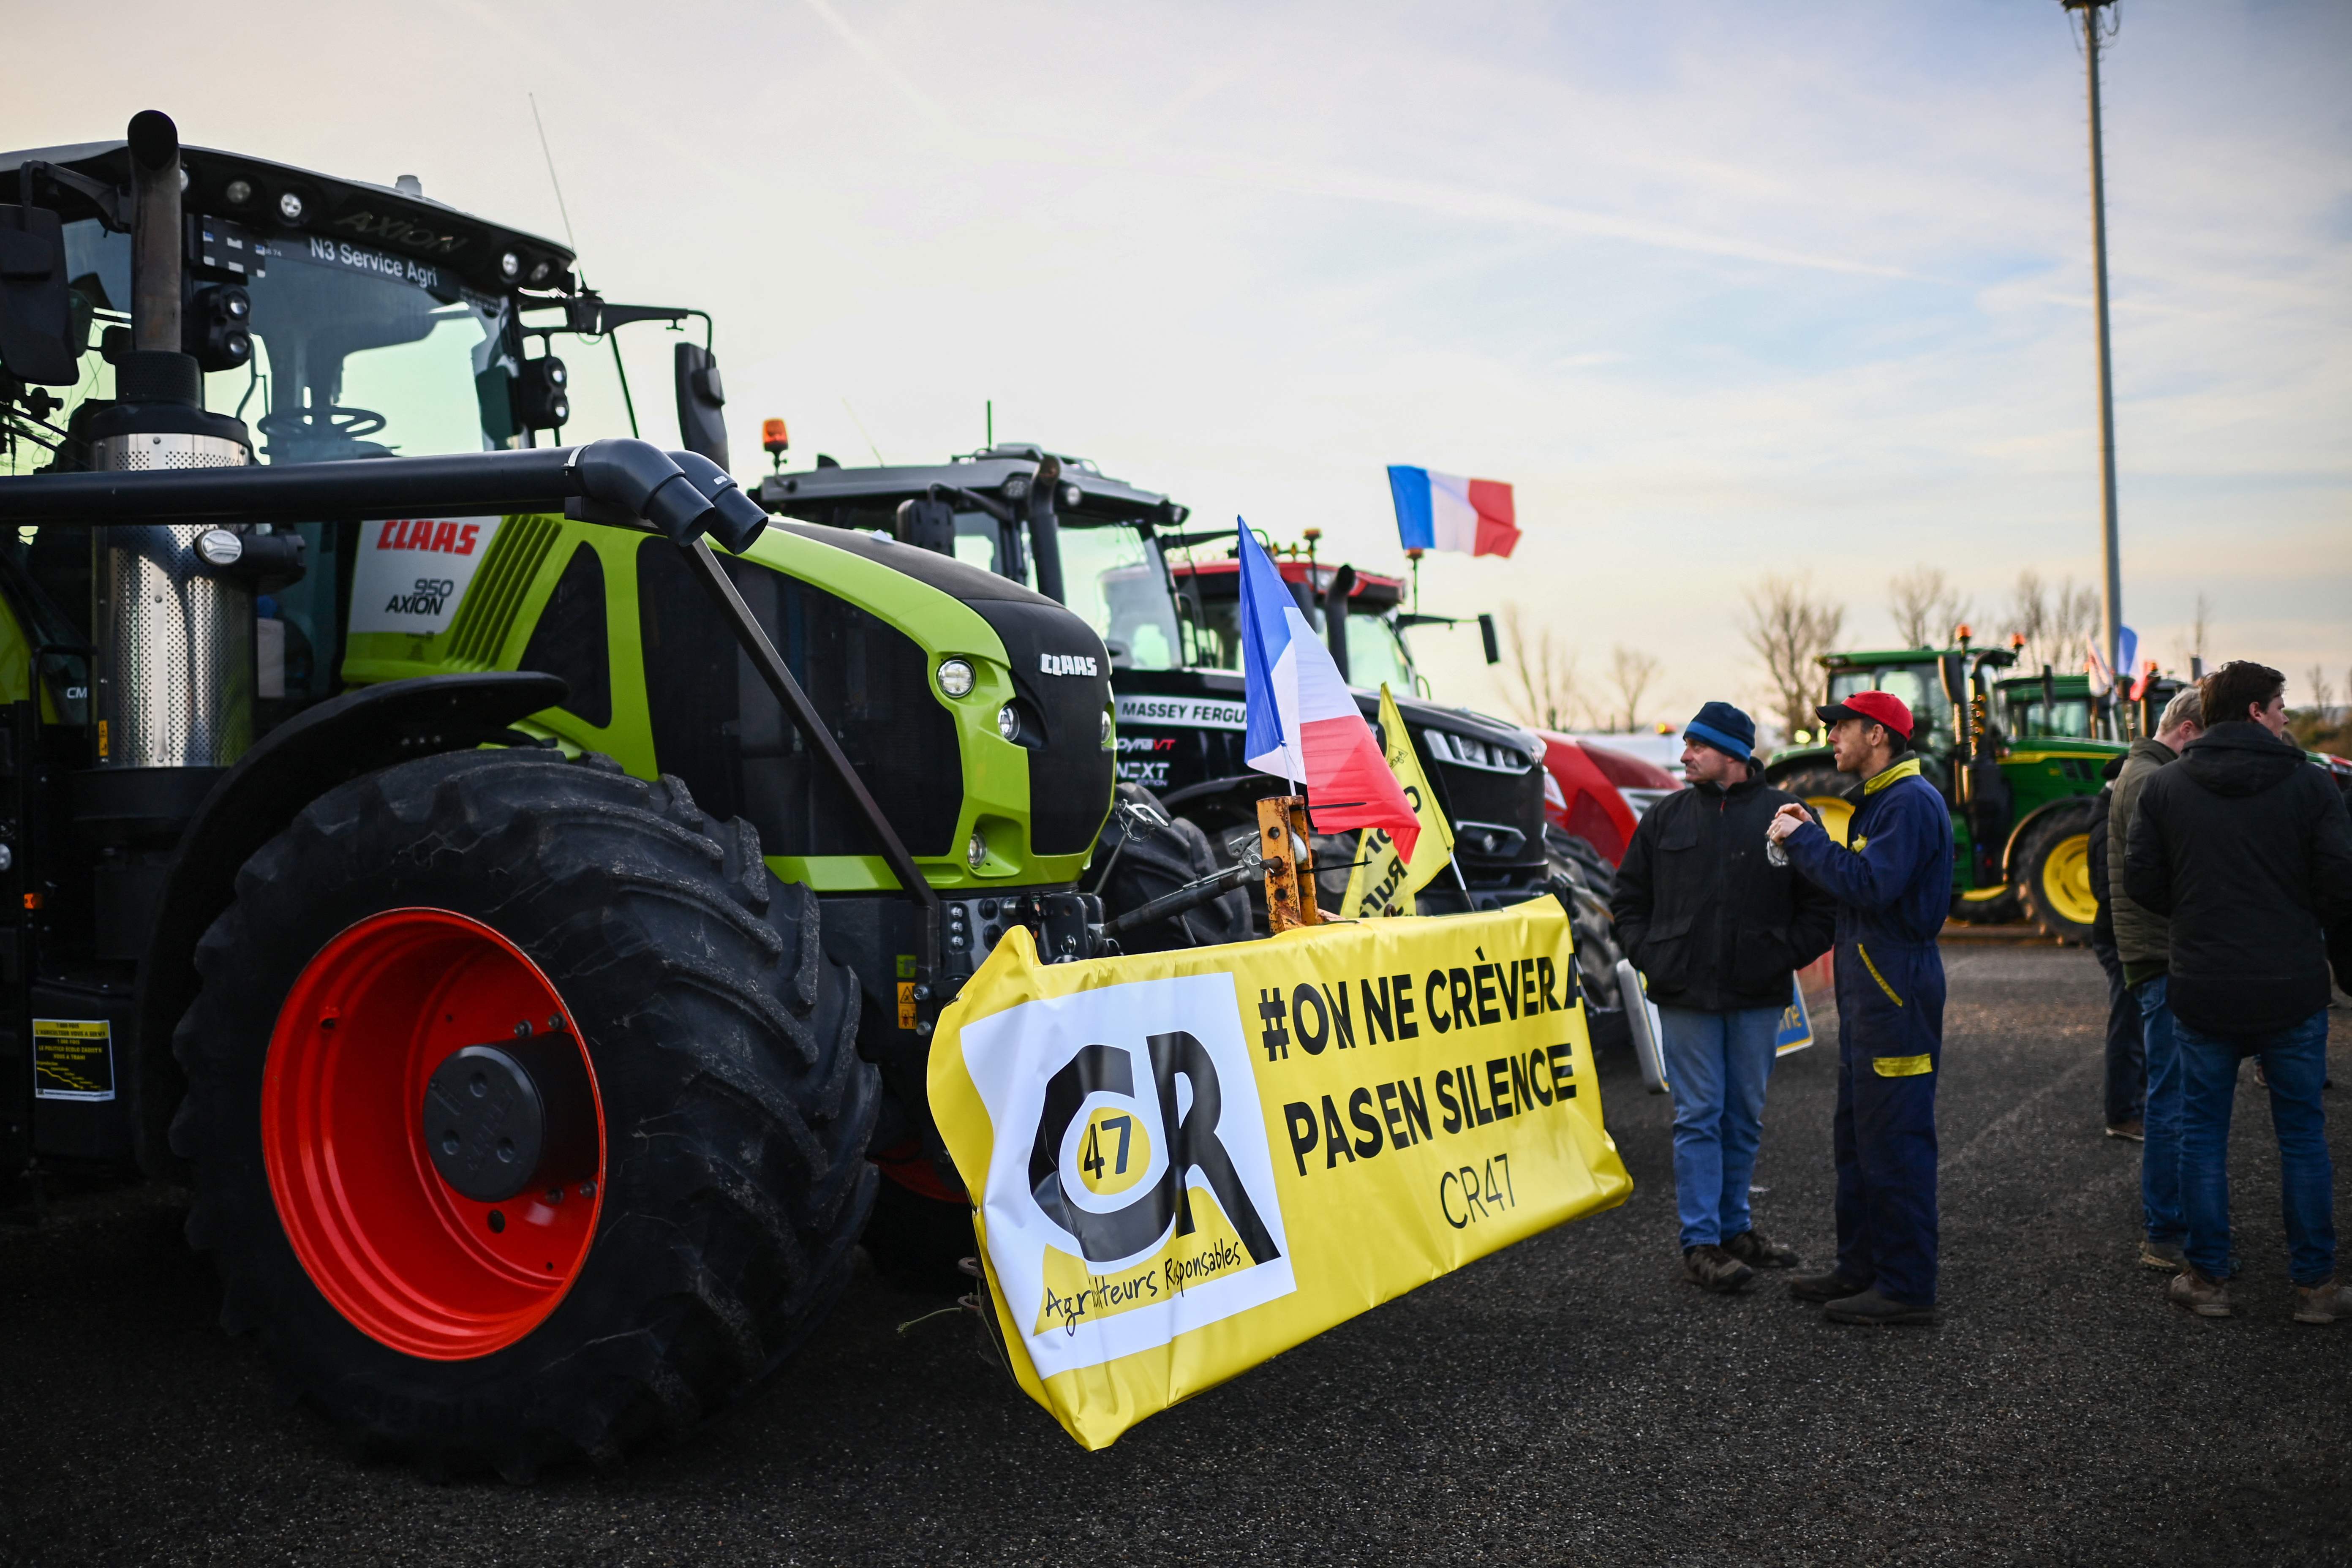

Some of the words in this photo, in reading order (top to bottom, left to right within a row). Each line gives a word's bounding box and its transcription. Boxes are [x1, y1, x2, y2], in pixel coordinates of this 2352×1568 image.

[310, 236, 335, 261] N3
[340, 243, 403, 277] Service
[407, 260, 437, 288] Agri
[377, 520, 480, 556] CLAAS
[385, 594, 444, 615] AXION
[413, 578, 454, 598] 950
[1040, 653, 1097, 676] CLAAS
[1122, 702, 1187, 719] MASSEY
[1193, 705, 1247, 723] FERGU
[1258, 981, 1356, 1062] #ON
[1361, 973, 1419, 1046] NE
[1436, 1043, 1578, 1134] SILENCE
[1029, 1031, 1282, 1266] CR
[1083, 1115, 1131, 1180] 47
[1440, 1153, 1516, 1230] CR47
